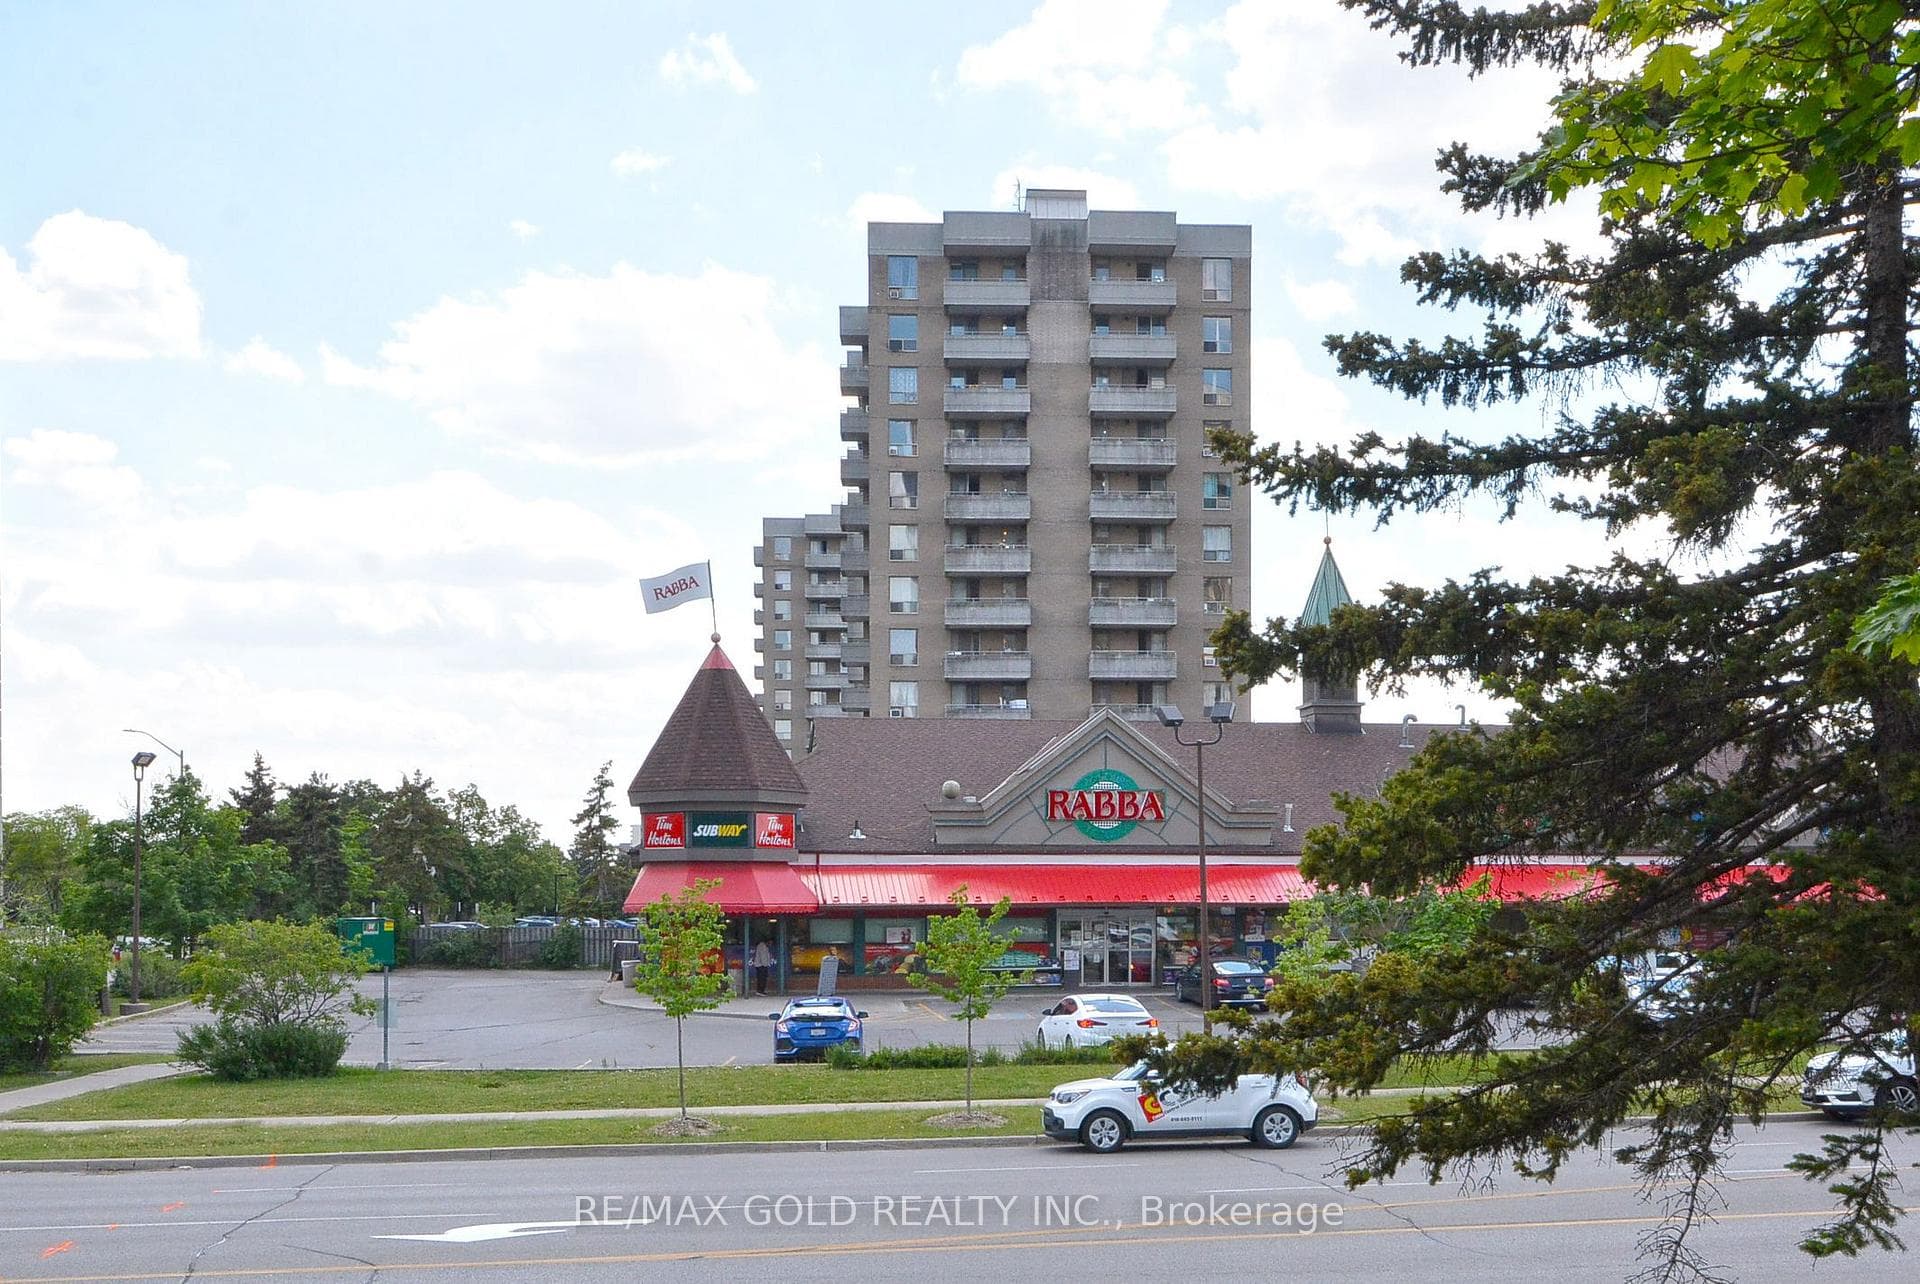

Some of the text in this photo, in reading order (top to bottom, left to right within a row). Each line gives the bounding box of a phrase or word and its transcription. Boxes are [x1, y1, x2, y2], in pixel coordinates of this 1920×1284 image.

[653, 576, 699, 600] RABBA
[1047, 790, 1165, 821] RABBA
[656, 816, 672, 830] Tim
[693, 824, 747, 837] SUBWAY
[767, 816, 783, 830] Tim
[647, 830, 682, 846] Hortons
[758, 831, 792, 846] Hortons
